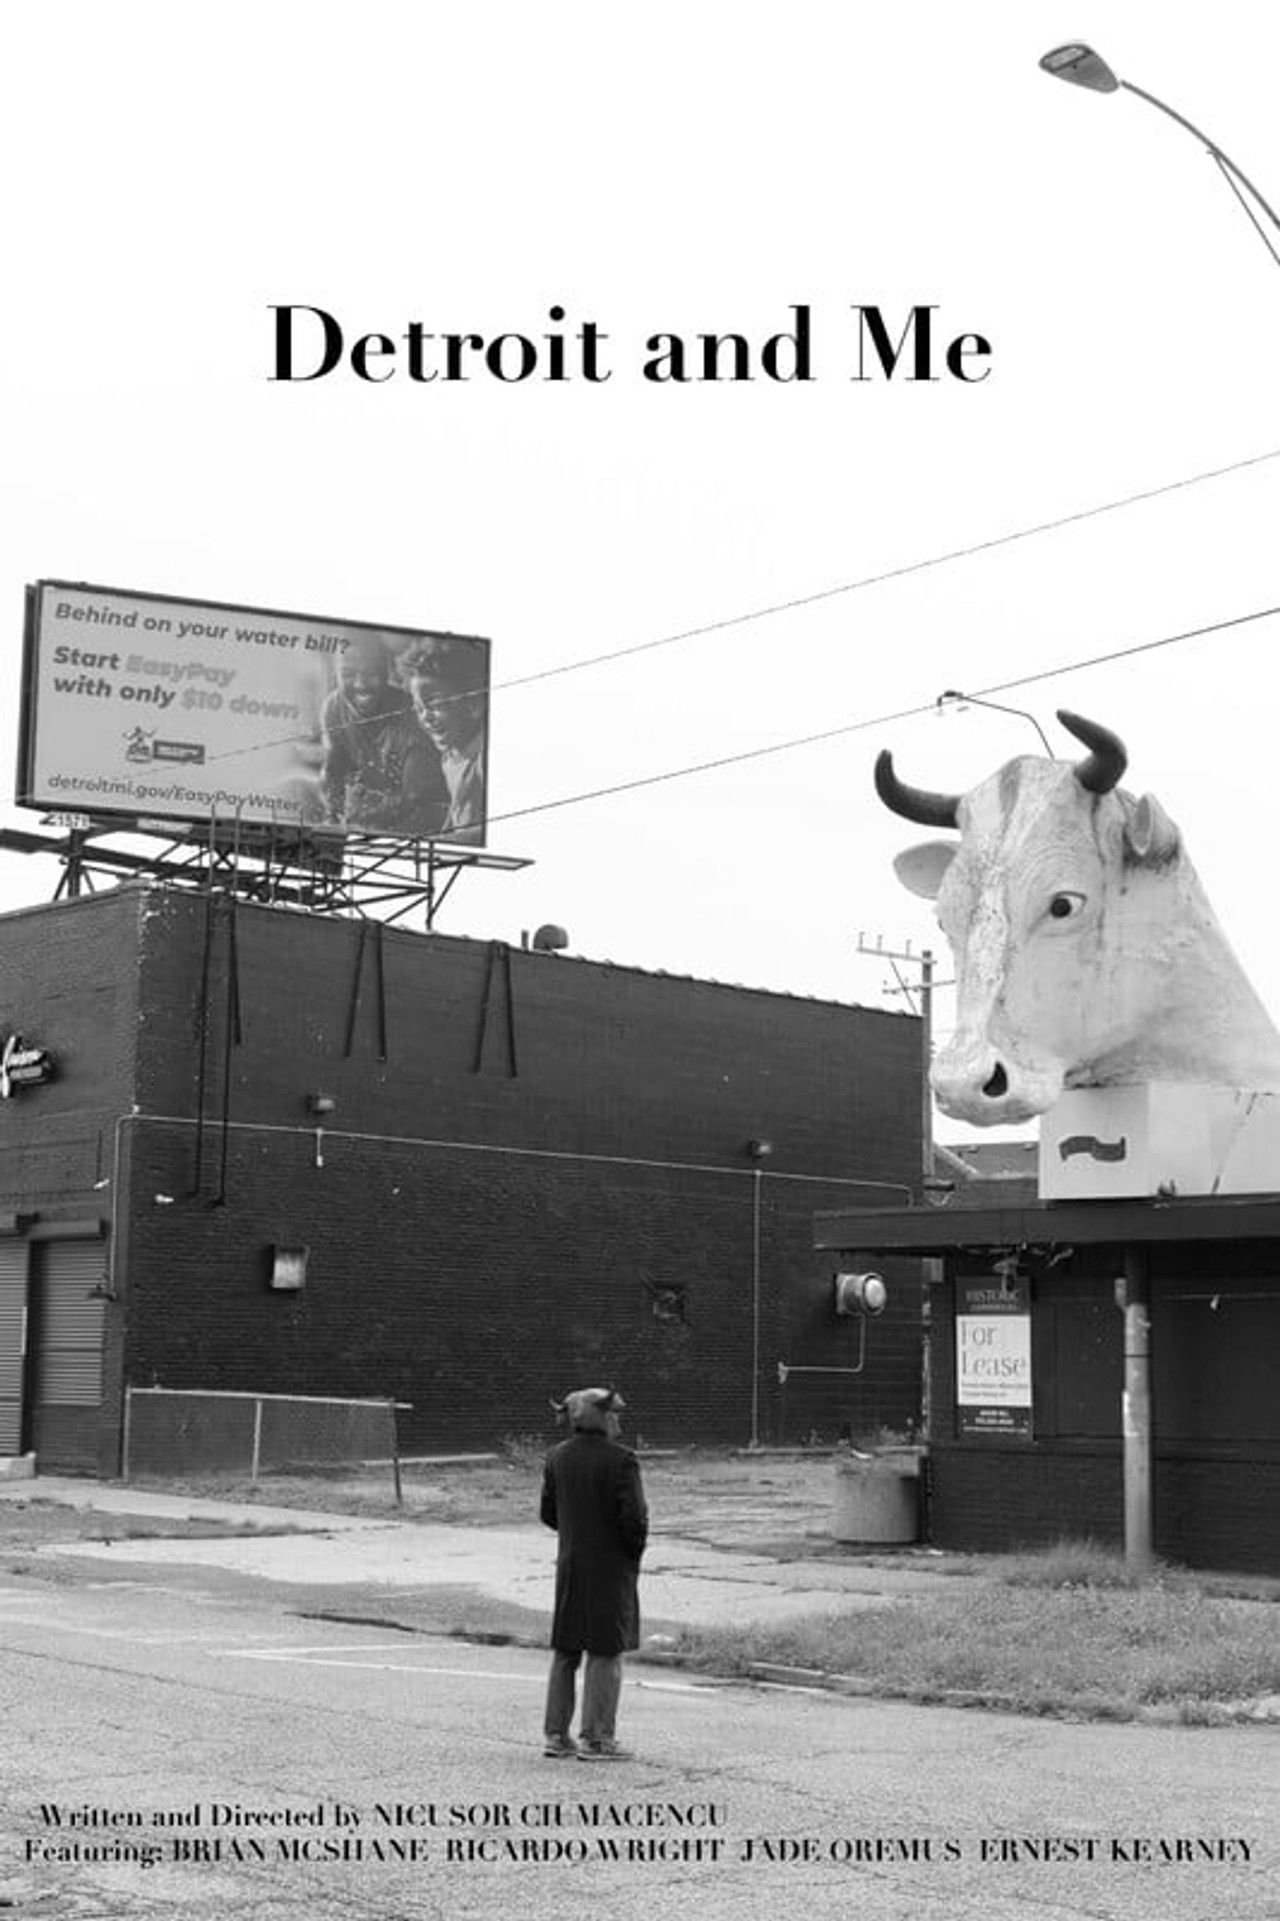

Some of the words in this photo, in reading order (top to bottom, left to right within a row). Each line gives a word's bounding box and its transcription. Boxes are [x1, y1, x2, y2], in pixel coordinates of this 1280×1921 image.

[54, 602, 139, 628] Behind
[143, 617, 172, 632] on
[176, 620, 229, 640] your
[234, 627, 300, 648] water
[304, 634, 351, 654] bill?
[53, 646, 121, 671] Start
[125, 654, 237, 687] EasyPay
[53, 675, 112, 698] with
[119, 684, 177, 709] only
[181, 687, 222, 711] $10
[229, 694, 300, 719] down
[48, 774, 299, 811] detroitmi.gov/EasyPayWater
[961, 1320, 998, 1346] For
[961, 1351, 1026, 1377] Lease
